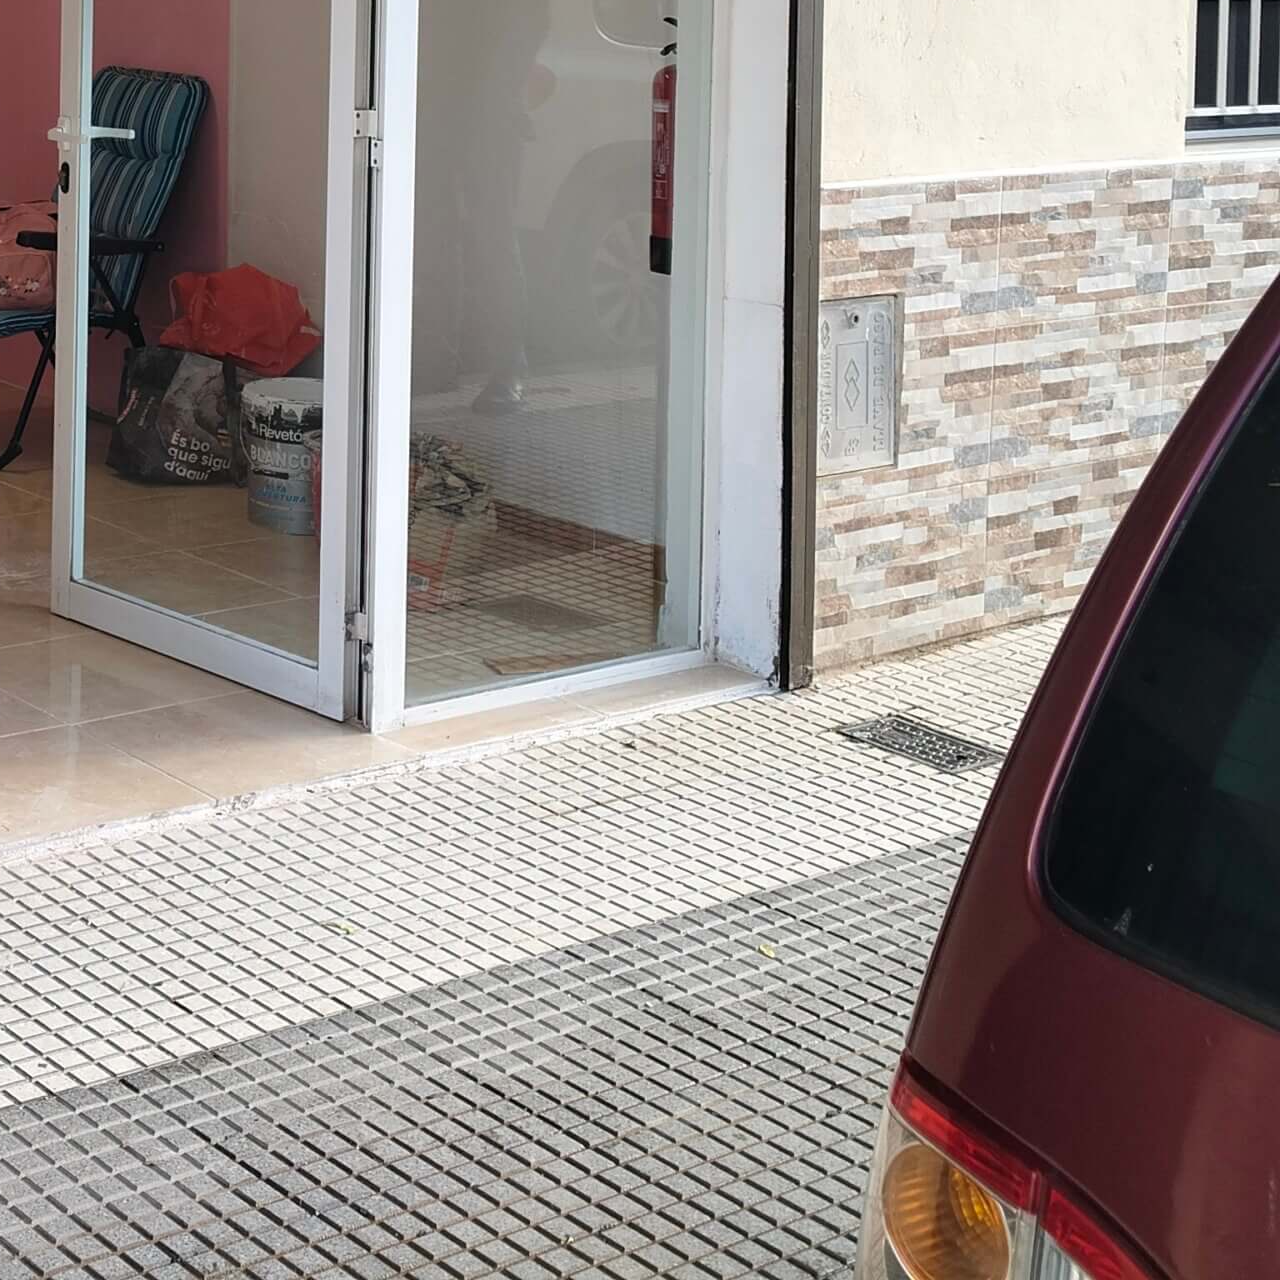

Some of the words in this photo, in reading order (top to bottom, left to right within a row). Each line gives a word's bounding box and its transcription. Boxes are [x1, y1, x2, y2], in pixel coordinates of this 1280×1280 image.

[170, 428, 188, 448] És
[190, 437, 211, 452] bo
[259, 423, 304, 442] Revetó
[167, 447, 199, 463] que
[201, 454, 232, 471] sigu
[250, 444, 312, 470] BLANCO
